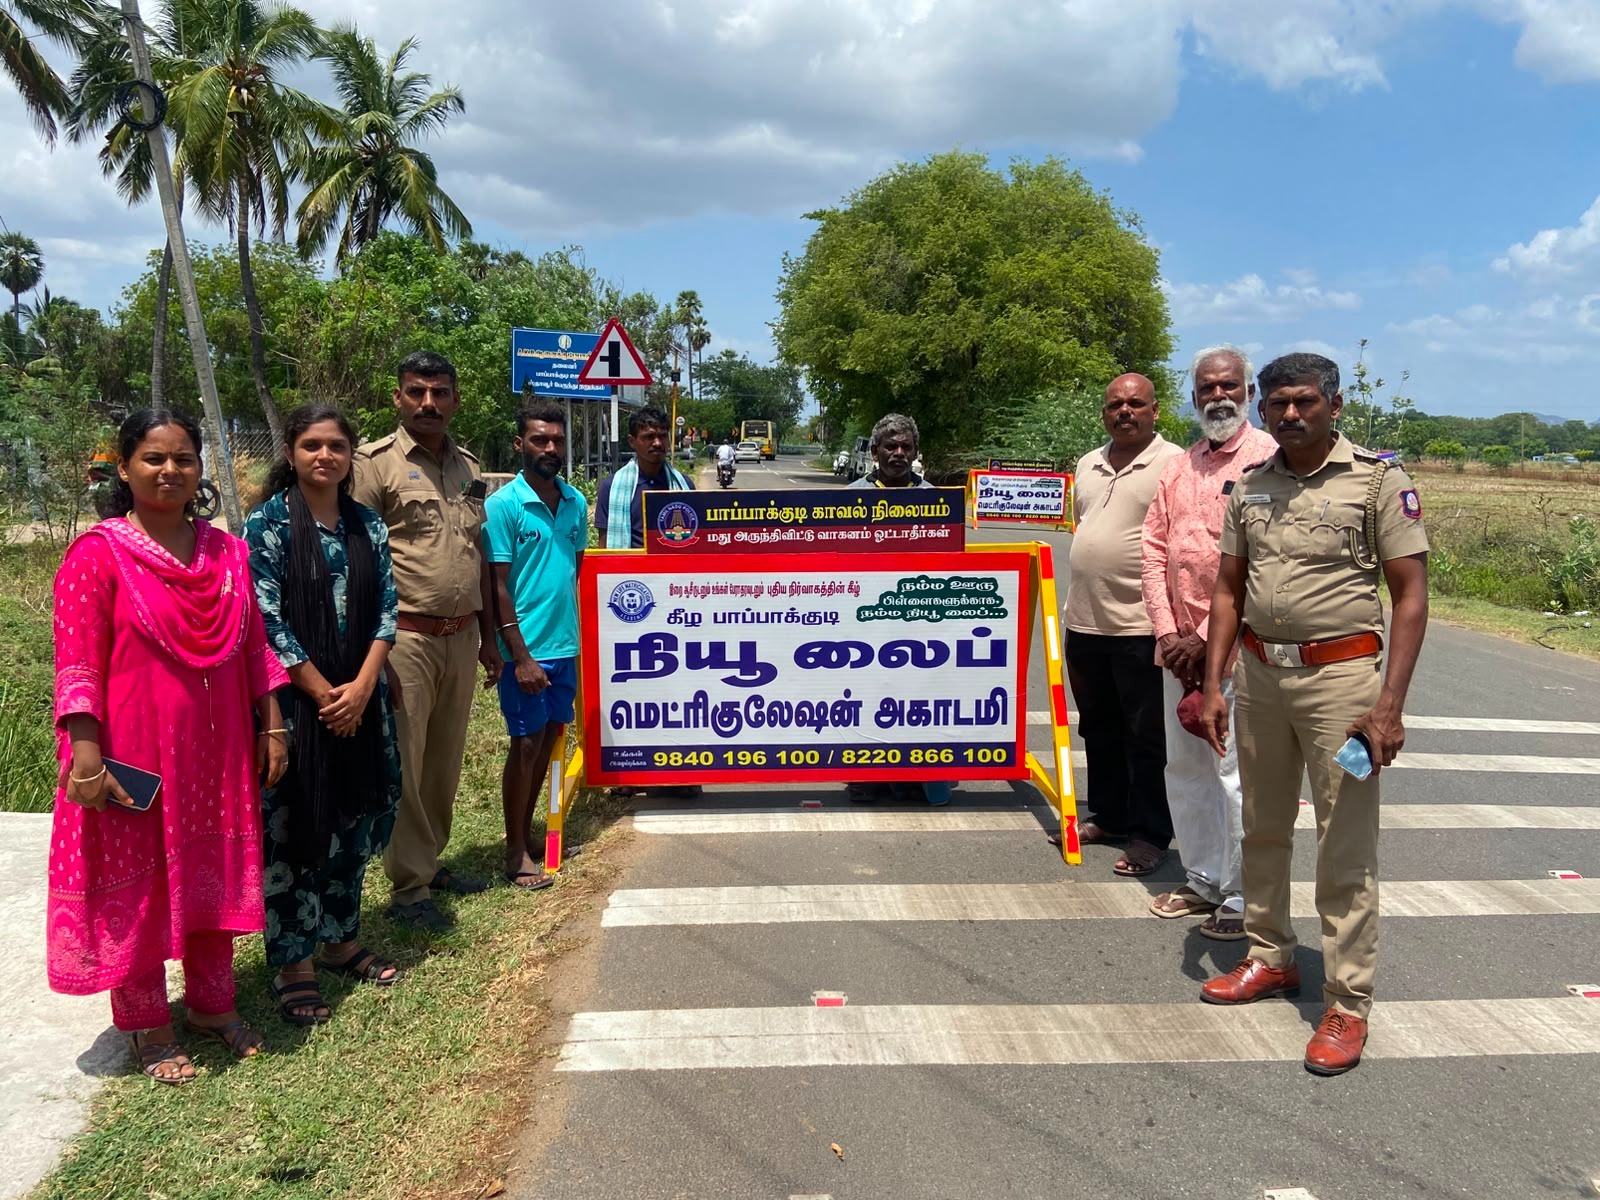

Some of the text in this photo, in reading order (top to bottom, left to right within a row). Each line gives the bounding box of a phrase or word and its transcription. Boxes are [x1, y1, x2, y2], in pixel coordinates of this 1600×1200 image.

[979, 487, 1062, 500] நியூ லைப்
[706, 497, 950, 524] பாப்பாக்குடி காவல் நிலையம்
[1033, 502, 1062, 512] அகாடமி
[707, 525, 950, 545] மது அருந்திவிட்டு வாகனம் ஓட்டாதீர்கள்
[767, 581, 786, 597] புதிய
[789, 580, 845, 597] நிர்வாகத்தின்
[847, 580, 861, 597] கீழ்
[901, 579, 994, 592] நம்ம ஊரு
[666, 607, 840, 627] கீழ பாப்பாக்குடி
[860, 608, 902, 619] நம்ம
[906, 608, 940, 620] நியூ
[610, 626, 1008, 688] நியூ லைப்
[610, 686, 1009, 739] மெட்ரிகுலேஷன் அகாடமி
[653, 748, 1007, 767] 9840 196 100 / 8220 866 100
